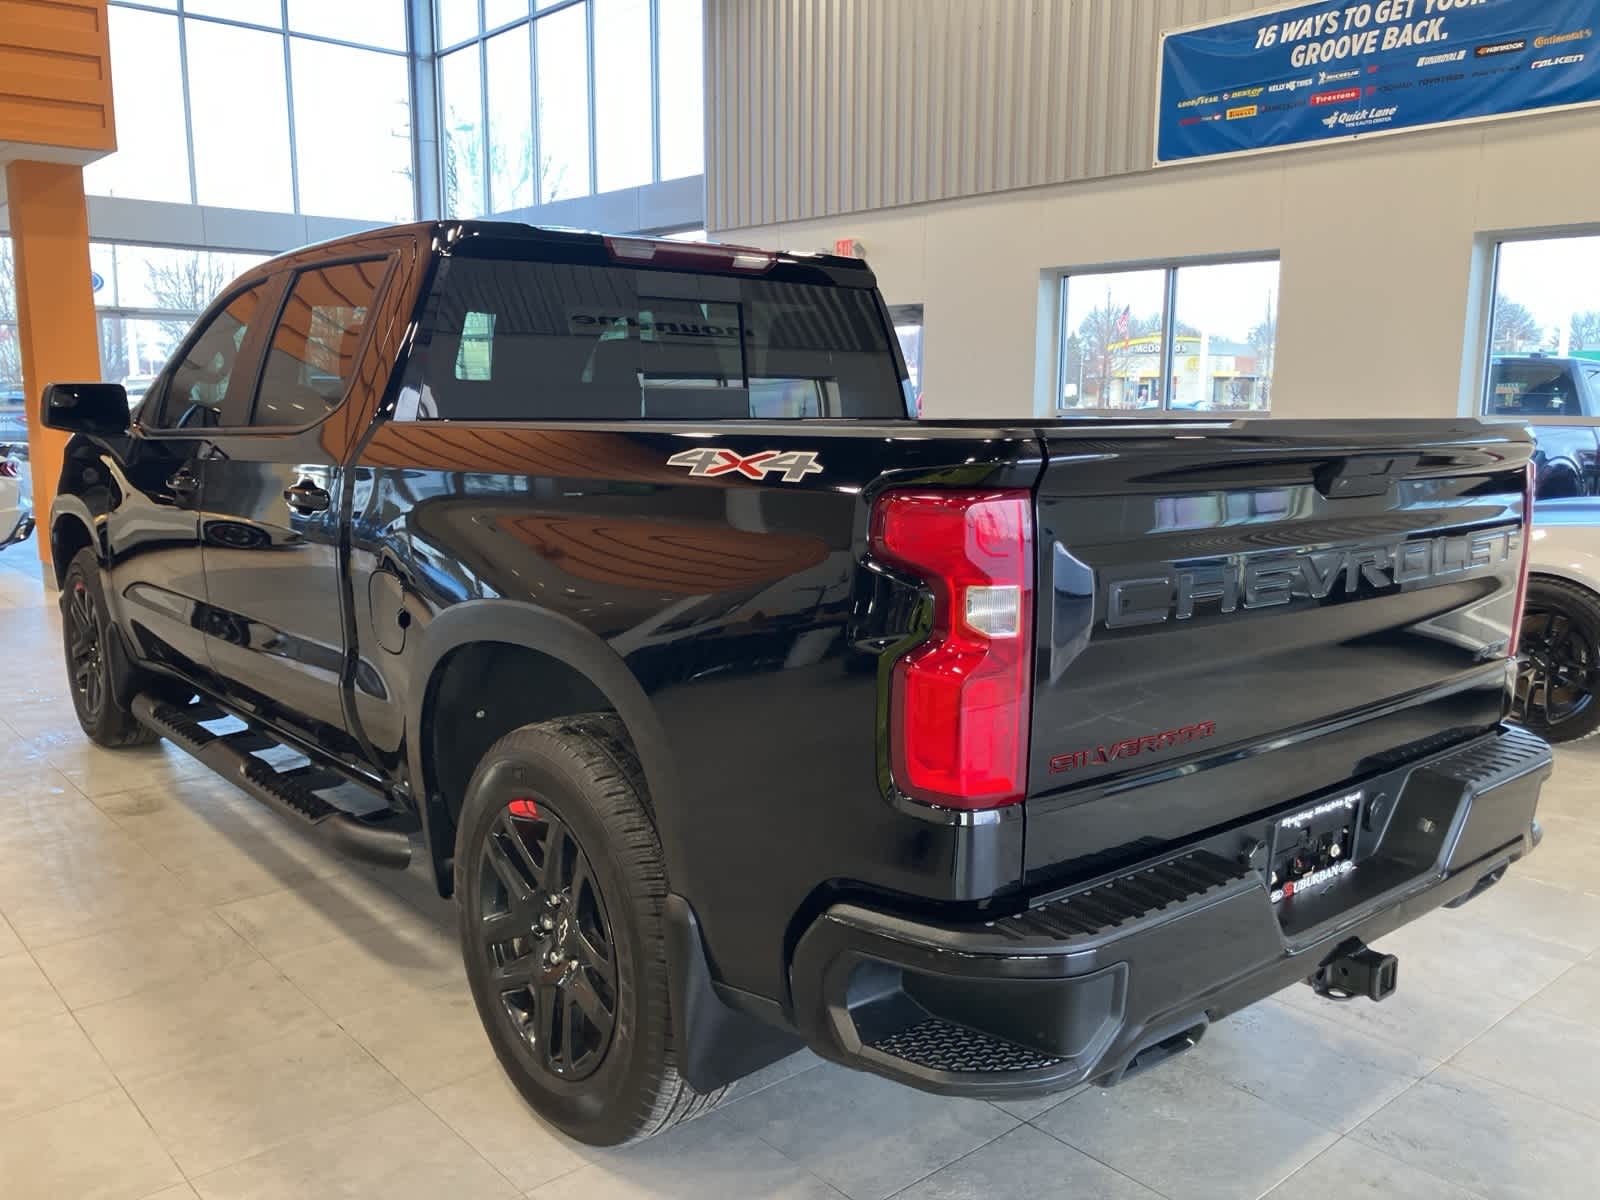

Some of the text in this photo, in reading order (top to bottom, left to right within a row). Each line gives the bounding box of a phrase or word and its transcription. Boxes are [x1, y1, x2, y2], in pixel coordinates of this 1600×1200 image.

[1254, 0, 1486, 49] 16 WAYS TO GET YO
[1291, 17, 1449, 68] GROOVE BACK.
[1530, 54, 1585, 69] FALKEN
[1315, 91, 1356, 104] Firestone
[1338, 107, 1397, 123] Quick Lane
[1105, 529, 1520, 630] CHEVROLET
[1050, 720, 1217, 775] SILVERADO
[1283, 865, 1340, 897] SUBURBAN
